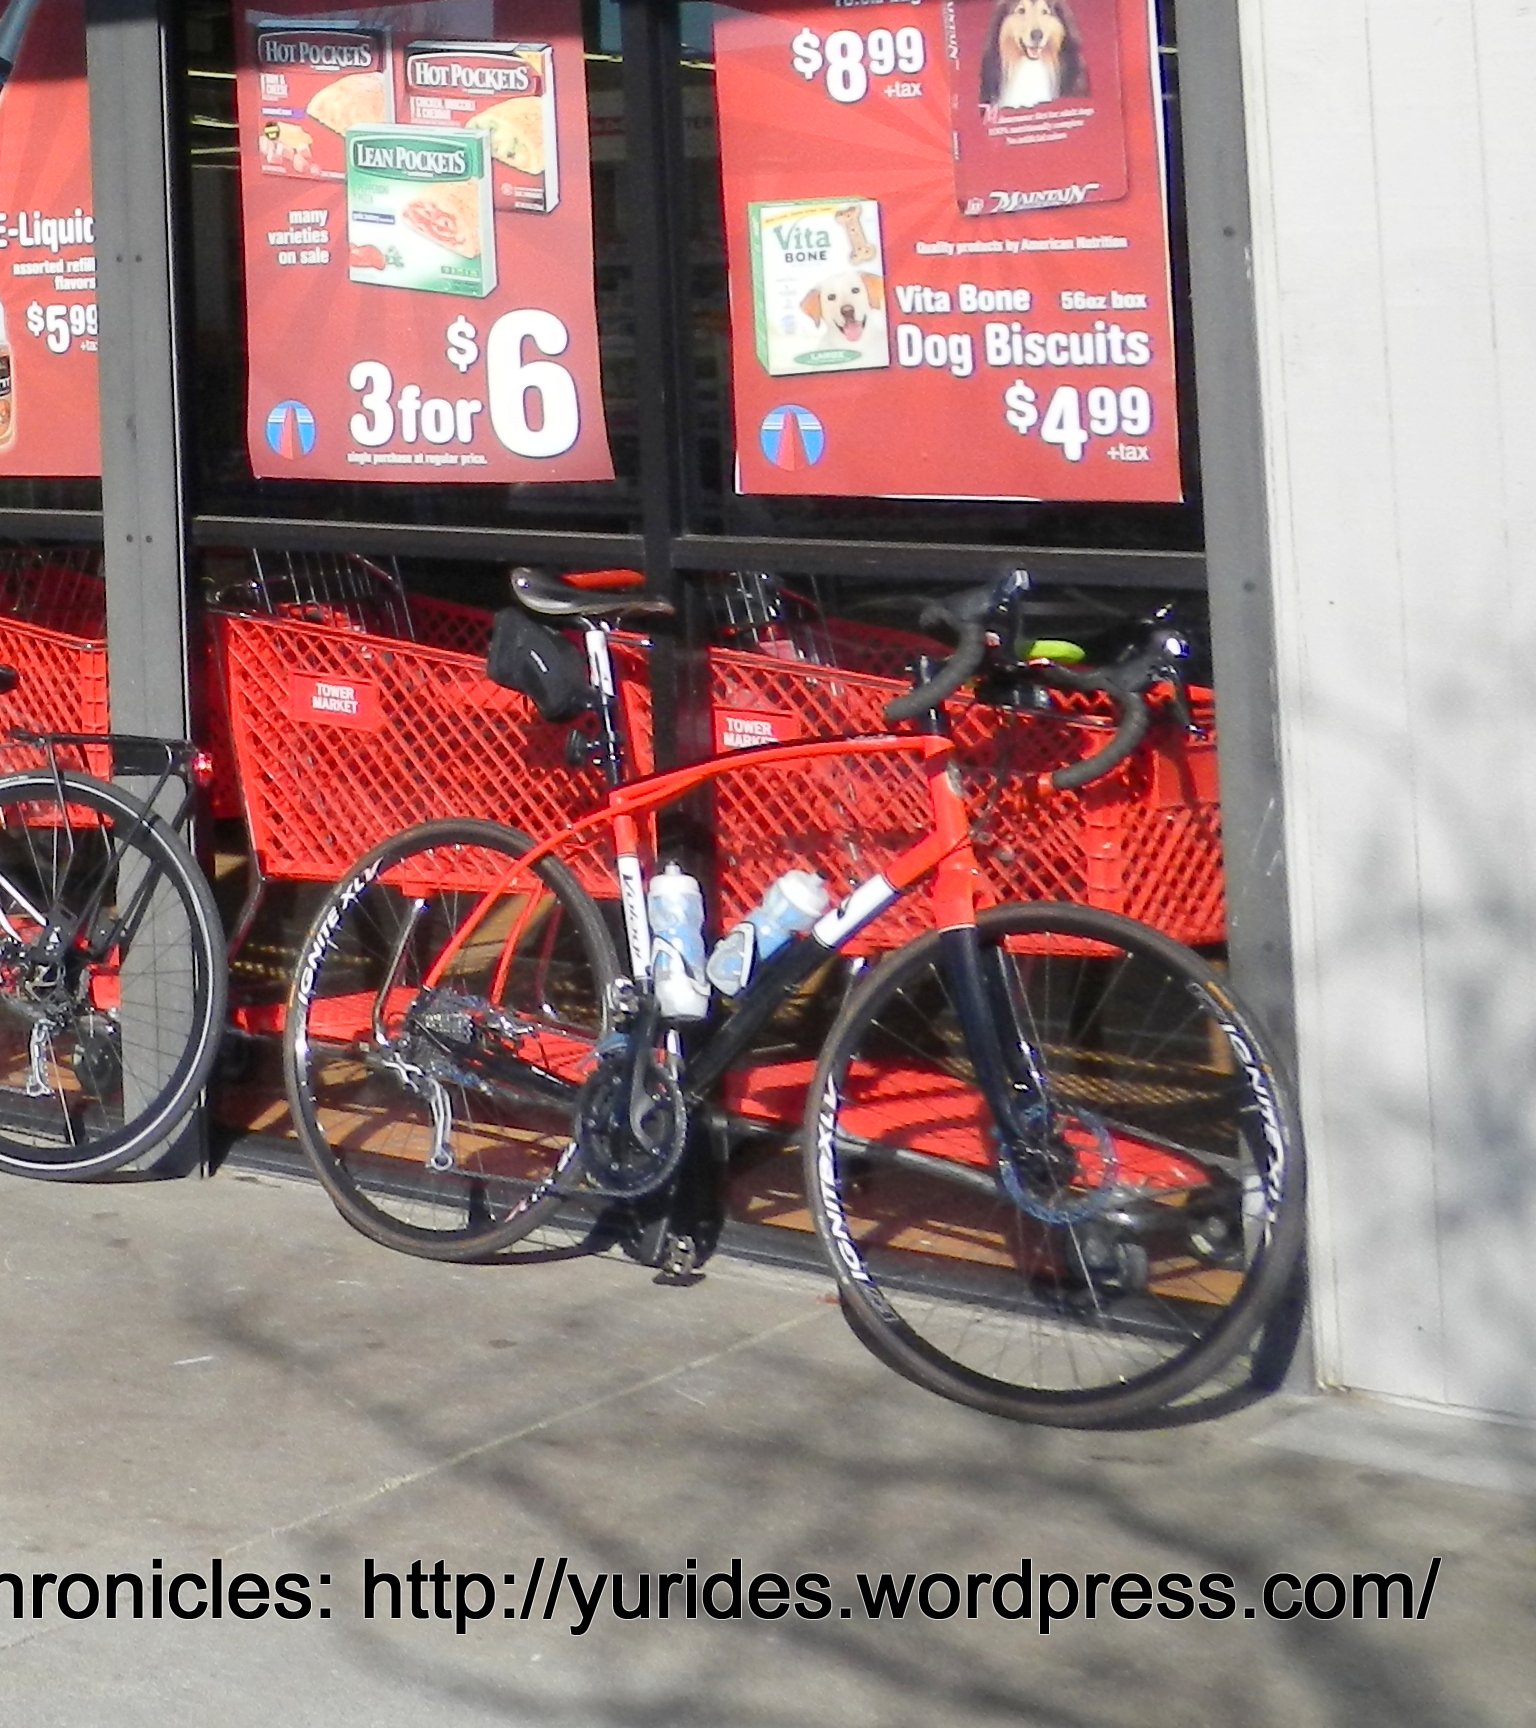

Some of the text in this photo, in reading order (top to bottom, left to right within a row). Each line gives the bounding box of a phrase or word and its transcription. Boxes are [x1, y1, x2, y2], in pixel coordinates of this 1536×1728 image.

[264, 40, 371, 68] HOT POCKETS
[415, 61, 529, 92] HOT POCKETS
[883, 81, 922, 98] +tax
[356, 143, 466, 174] LEAN POCKETS
[289, 209, 328, 227] many
[268, 227, 329, 246] varieties
[773, 222, 831, 250] Vita
[279, 247, 330, 265] on sale
[785, 250, 828, 263] BONE
[896, 283, 1147, 313] Vita Bone 56oz box
[896, 320, 1151, 377] Dog Biscuits
[1107, 443, 1149, 461] +tax
[315, 682, 355, 700] TOWER
[312, 696, 359, 714] MARKET
[725, 717, 772, 736] TOWER
